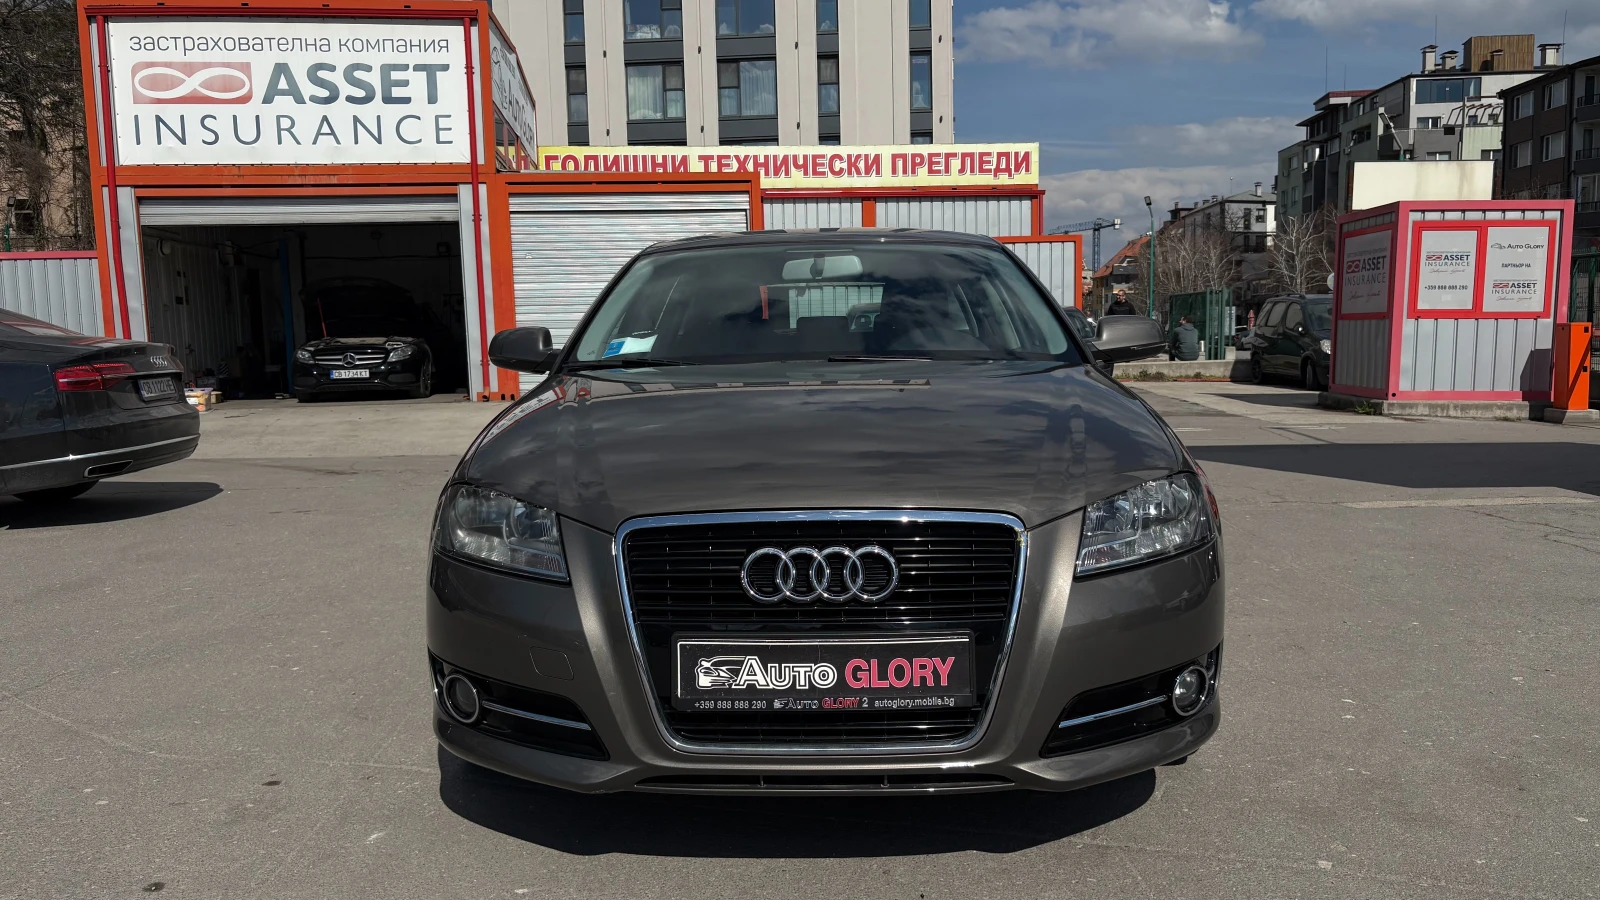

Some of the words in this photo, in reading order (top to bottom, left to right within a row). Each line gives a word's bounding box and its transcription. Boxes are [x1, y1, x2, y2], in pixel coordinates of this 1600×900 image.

[129, 36, 331, 56] застрахователна
[338, 37, 450, 53] компания
[260, 62, 450, 105] ASSET
[133, 114, 454, 146] INSURANCE
[697, 153, 883, 179] ТЕХНИЧЕСКИ
[890, 151, 1032, 180] ПРЕГЛЕДИ
[1361, 255, 1387, 272] ASSET
[1344, 272, 1386, 287] INSURANCE
[844, 656, 955, 689] GLORY
[694, 700, 715, 709] +359
[716, 700, 732, 709] 888
[734, 700, 750, 709] 888
[751, 700, 767, 709] 290
[821, 697, 860, 709] GLORY
[861, 697, 869, 707] 2
[874, 696, 955, 708] autoglory.mobile.bg
